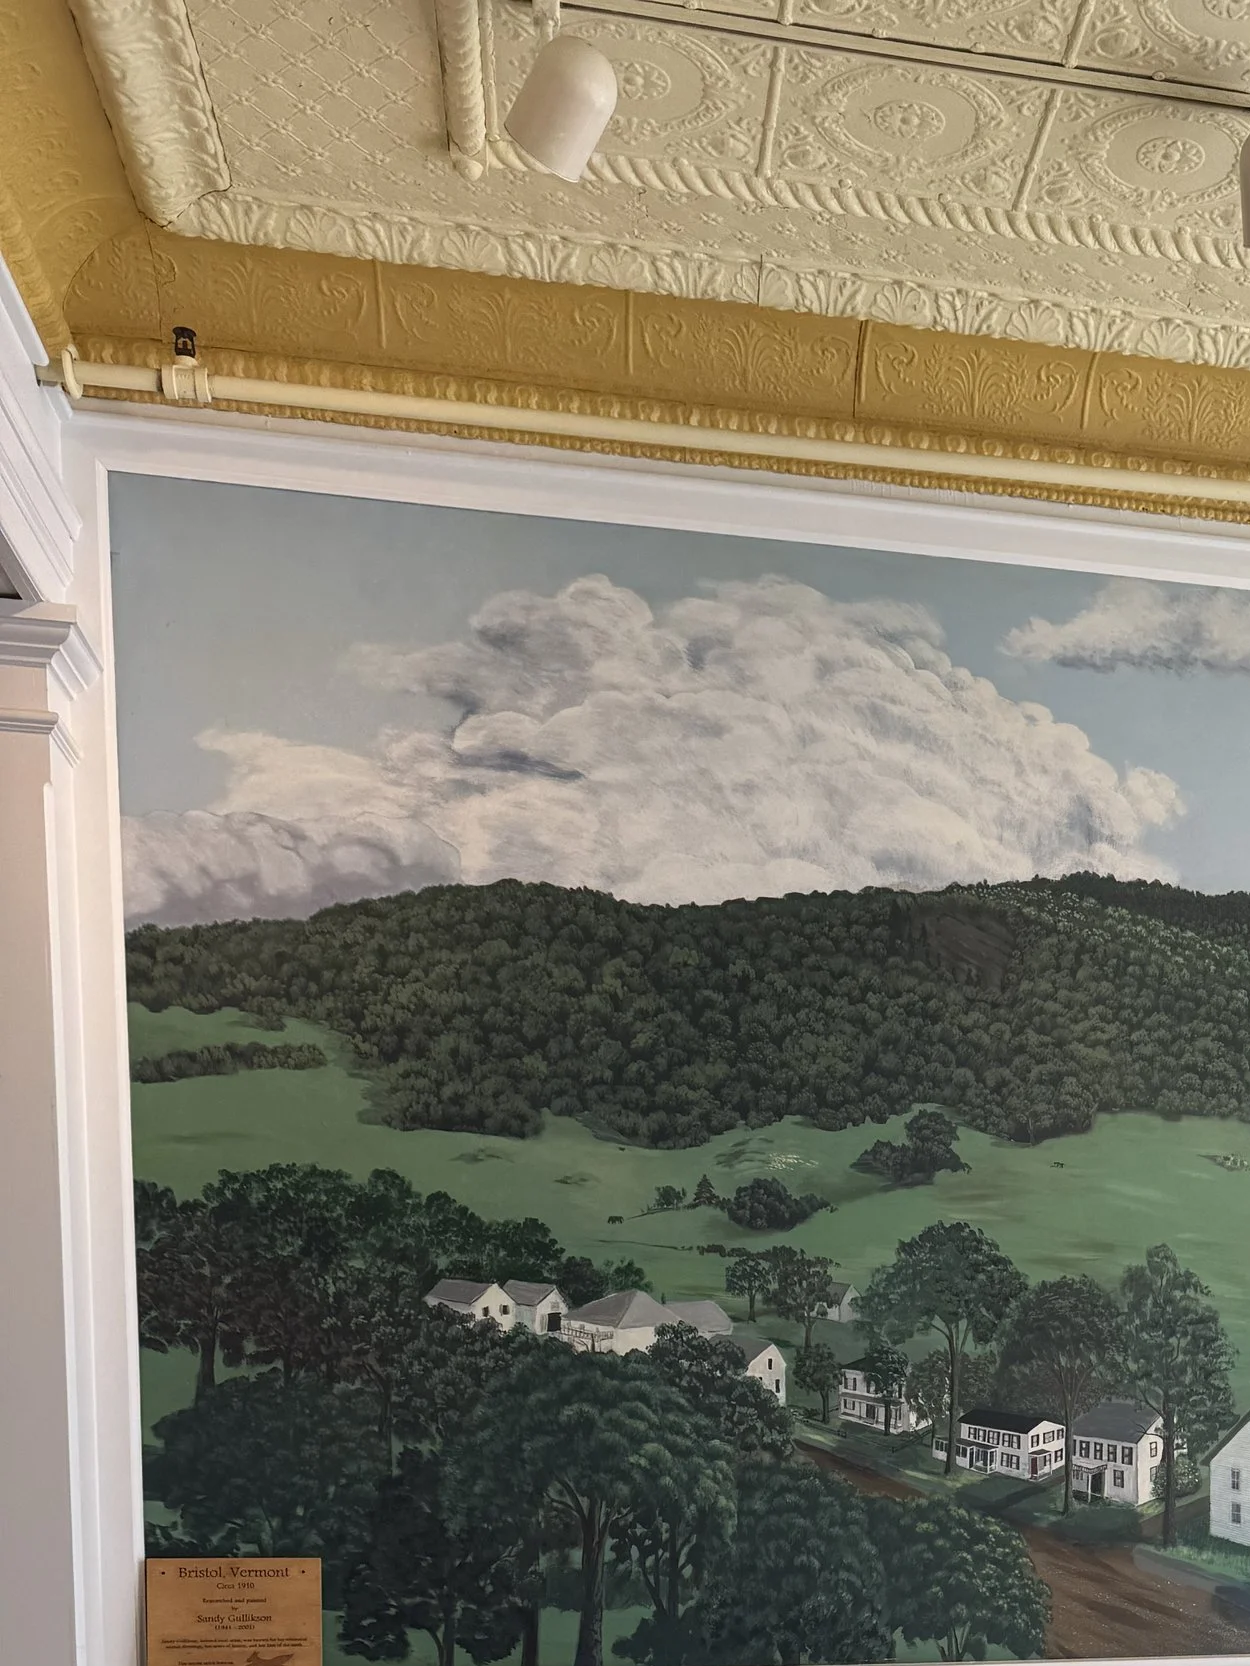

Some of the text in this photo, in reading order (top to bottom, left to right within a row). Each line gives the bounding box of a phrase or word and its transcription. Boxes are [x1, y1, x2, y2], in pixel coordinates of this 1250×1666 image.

[179, 1566, 290, 1579] Bristol, Vermont
[216, 1582, 235, 1590] Circa
[197, 1614, 272, 1624] Sandy Gullikson
